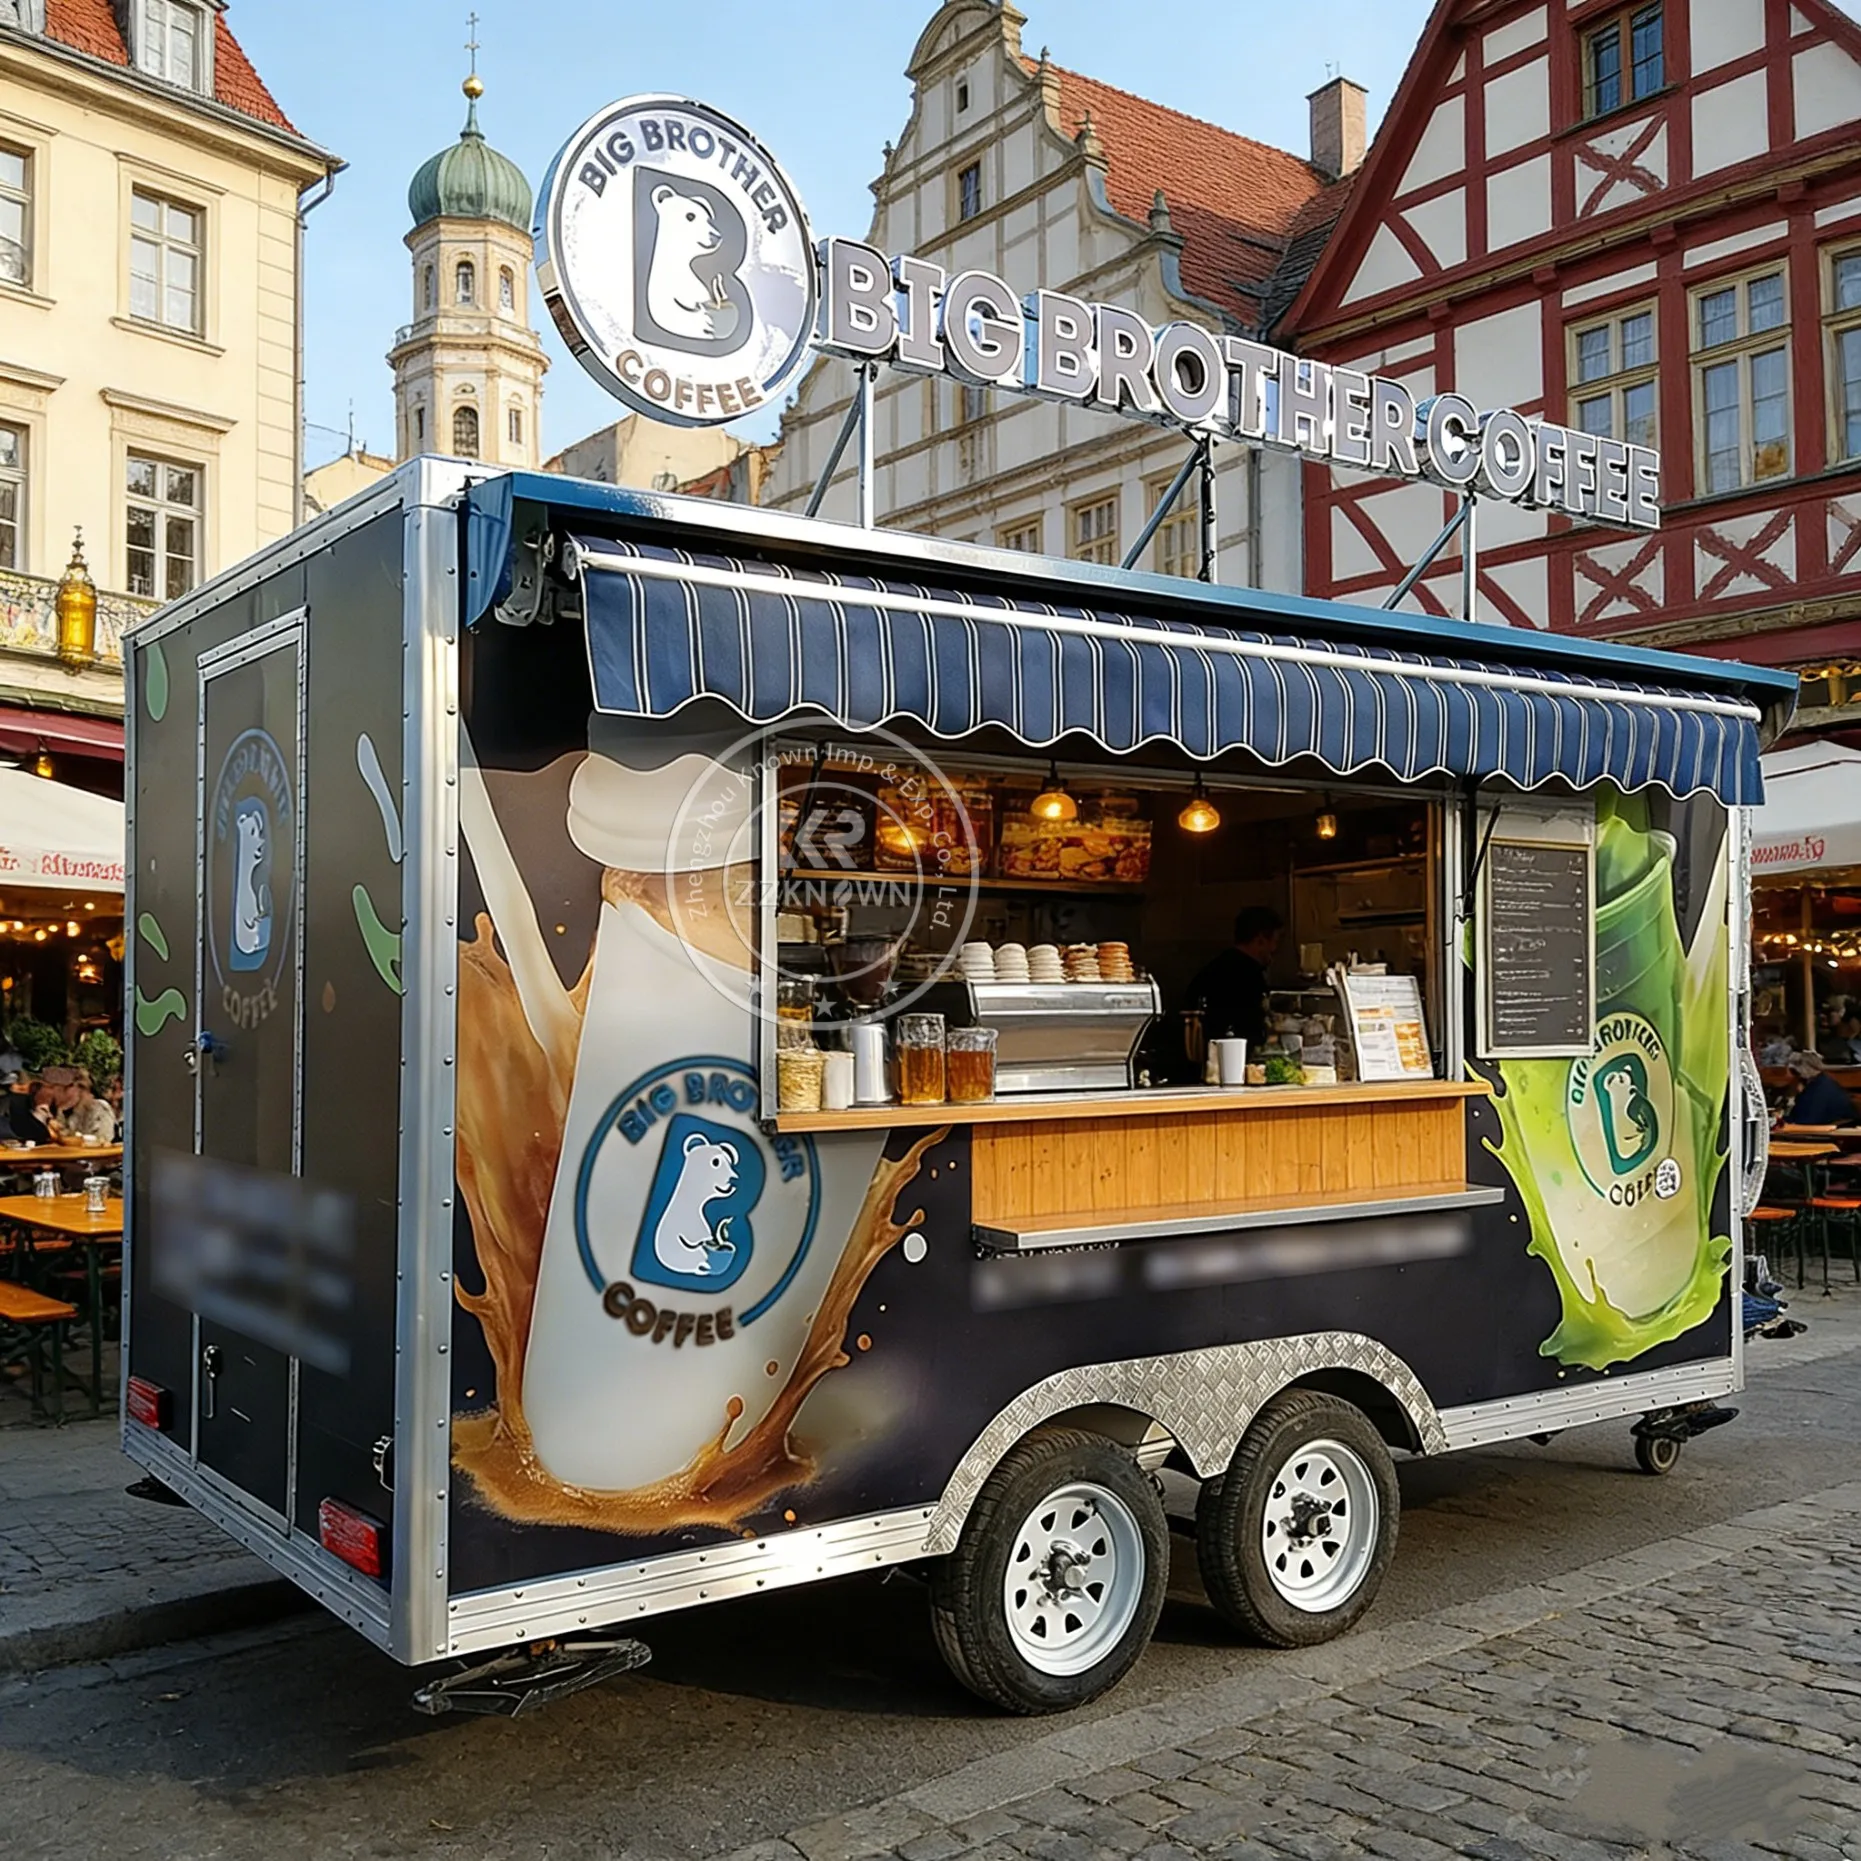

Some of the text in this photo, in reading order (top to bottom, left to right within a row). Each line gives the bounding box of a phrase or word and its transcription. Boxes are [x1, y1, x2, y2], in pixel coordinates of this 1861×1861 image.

[578, 119, 788, 235] BIG BROTHER
[615, 349, 763, 414] COFFEE
[824, 236, 1661, 530] BIG BROTHER COFFEE
[617, 1072, 805, 1184] BIG BROER
[603, 1281, 735, 1349] COFFEE
